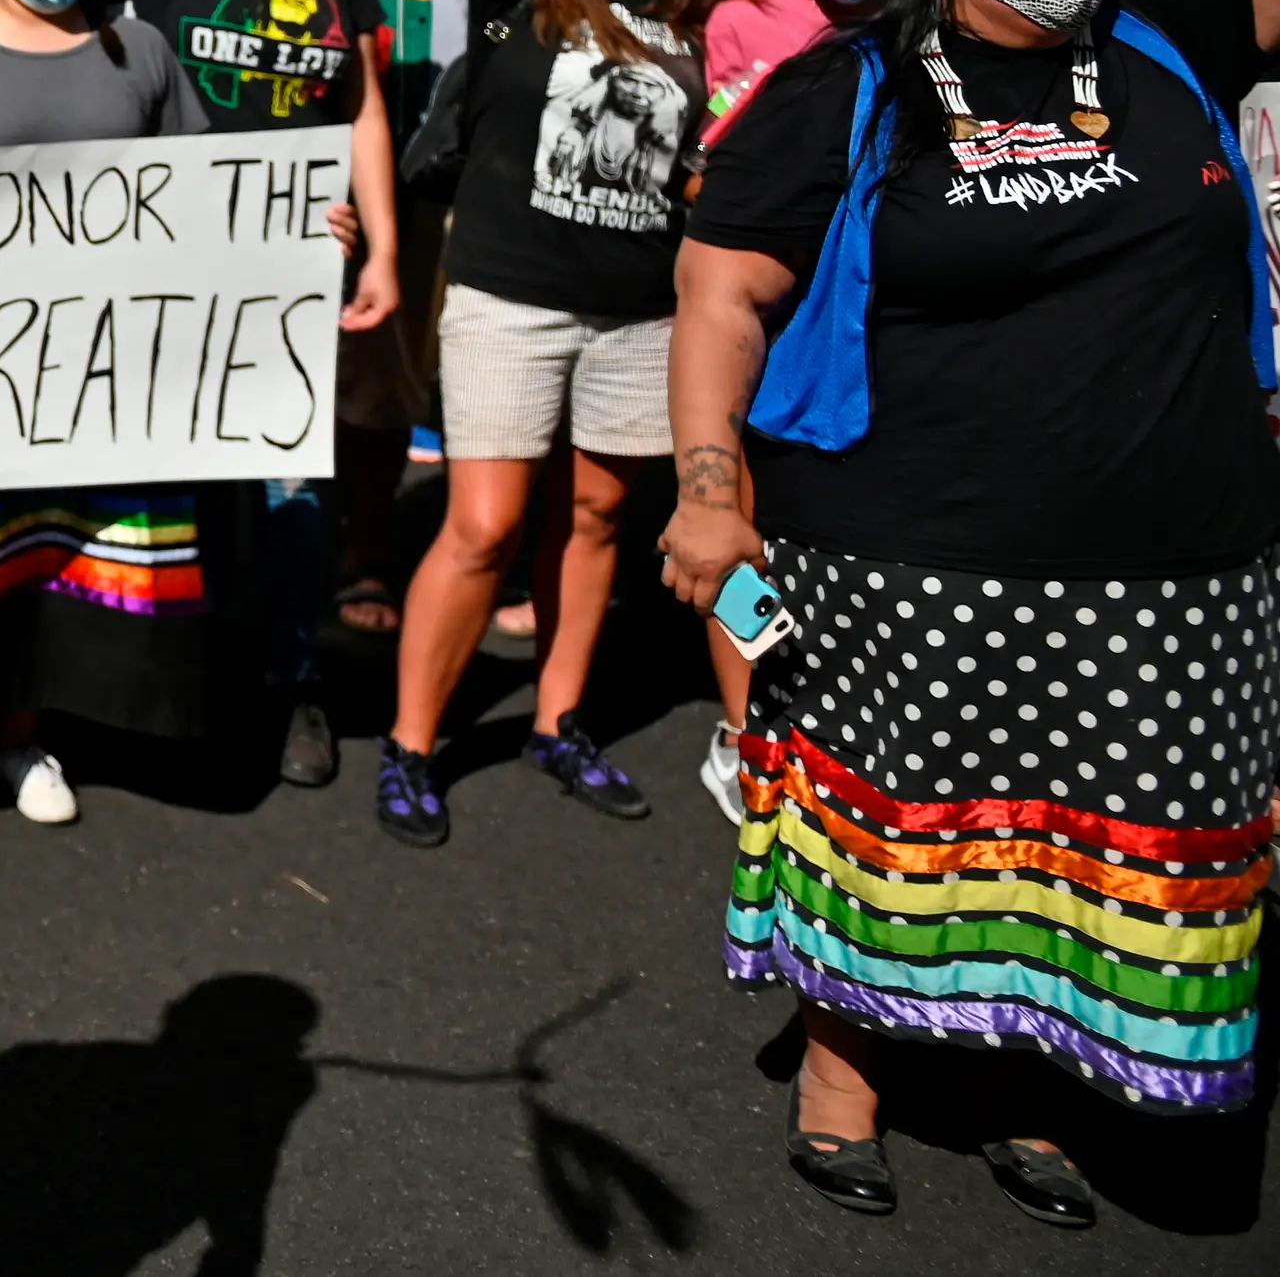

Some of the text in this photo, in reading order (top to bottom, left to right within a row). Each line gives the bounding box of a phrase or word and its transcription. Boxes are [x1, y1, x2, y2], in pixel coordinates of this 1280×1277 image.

[191, 26, 345, 80] ONE LOV
[210, 158, 340, 242] THE
[529, 188, 573, 220] WHEN
[573, 204, 596, 225] DO
[598, 208, 628, 231] YOU
[945, 153, 1139, 212] #LANDBACK
